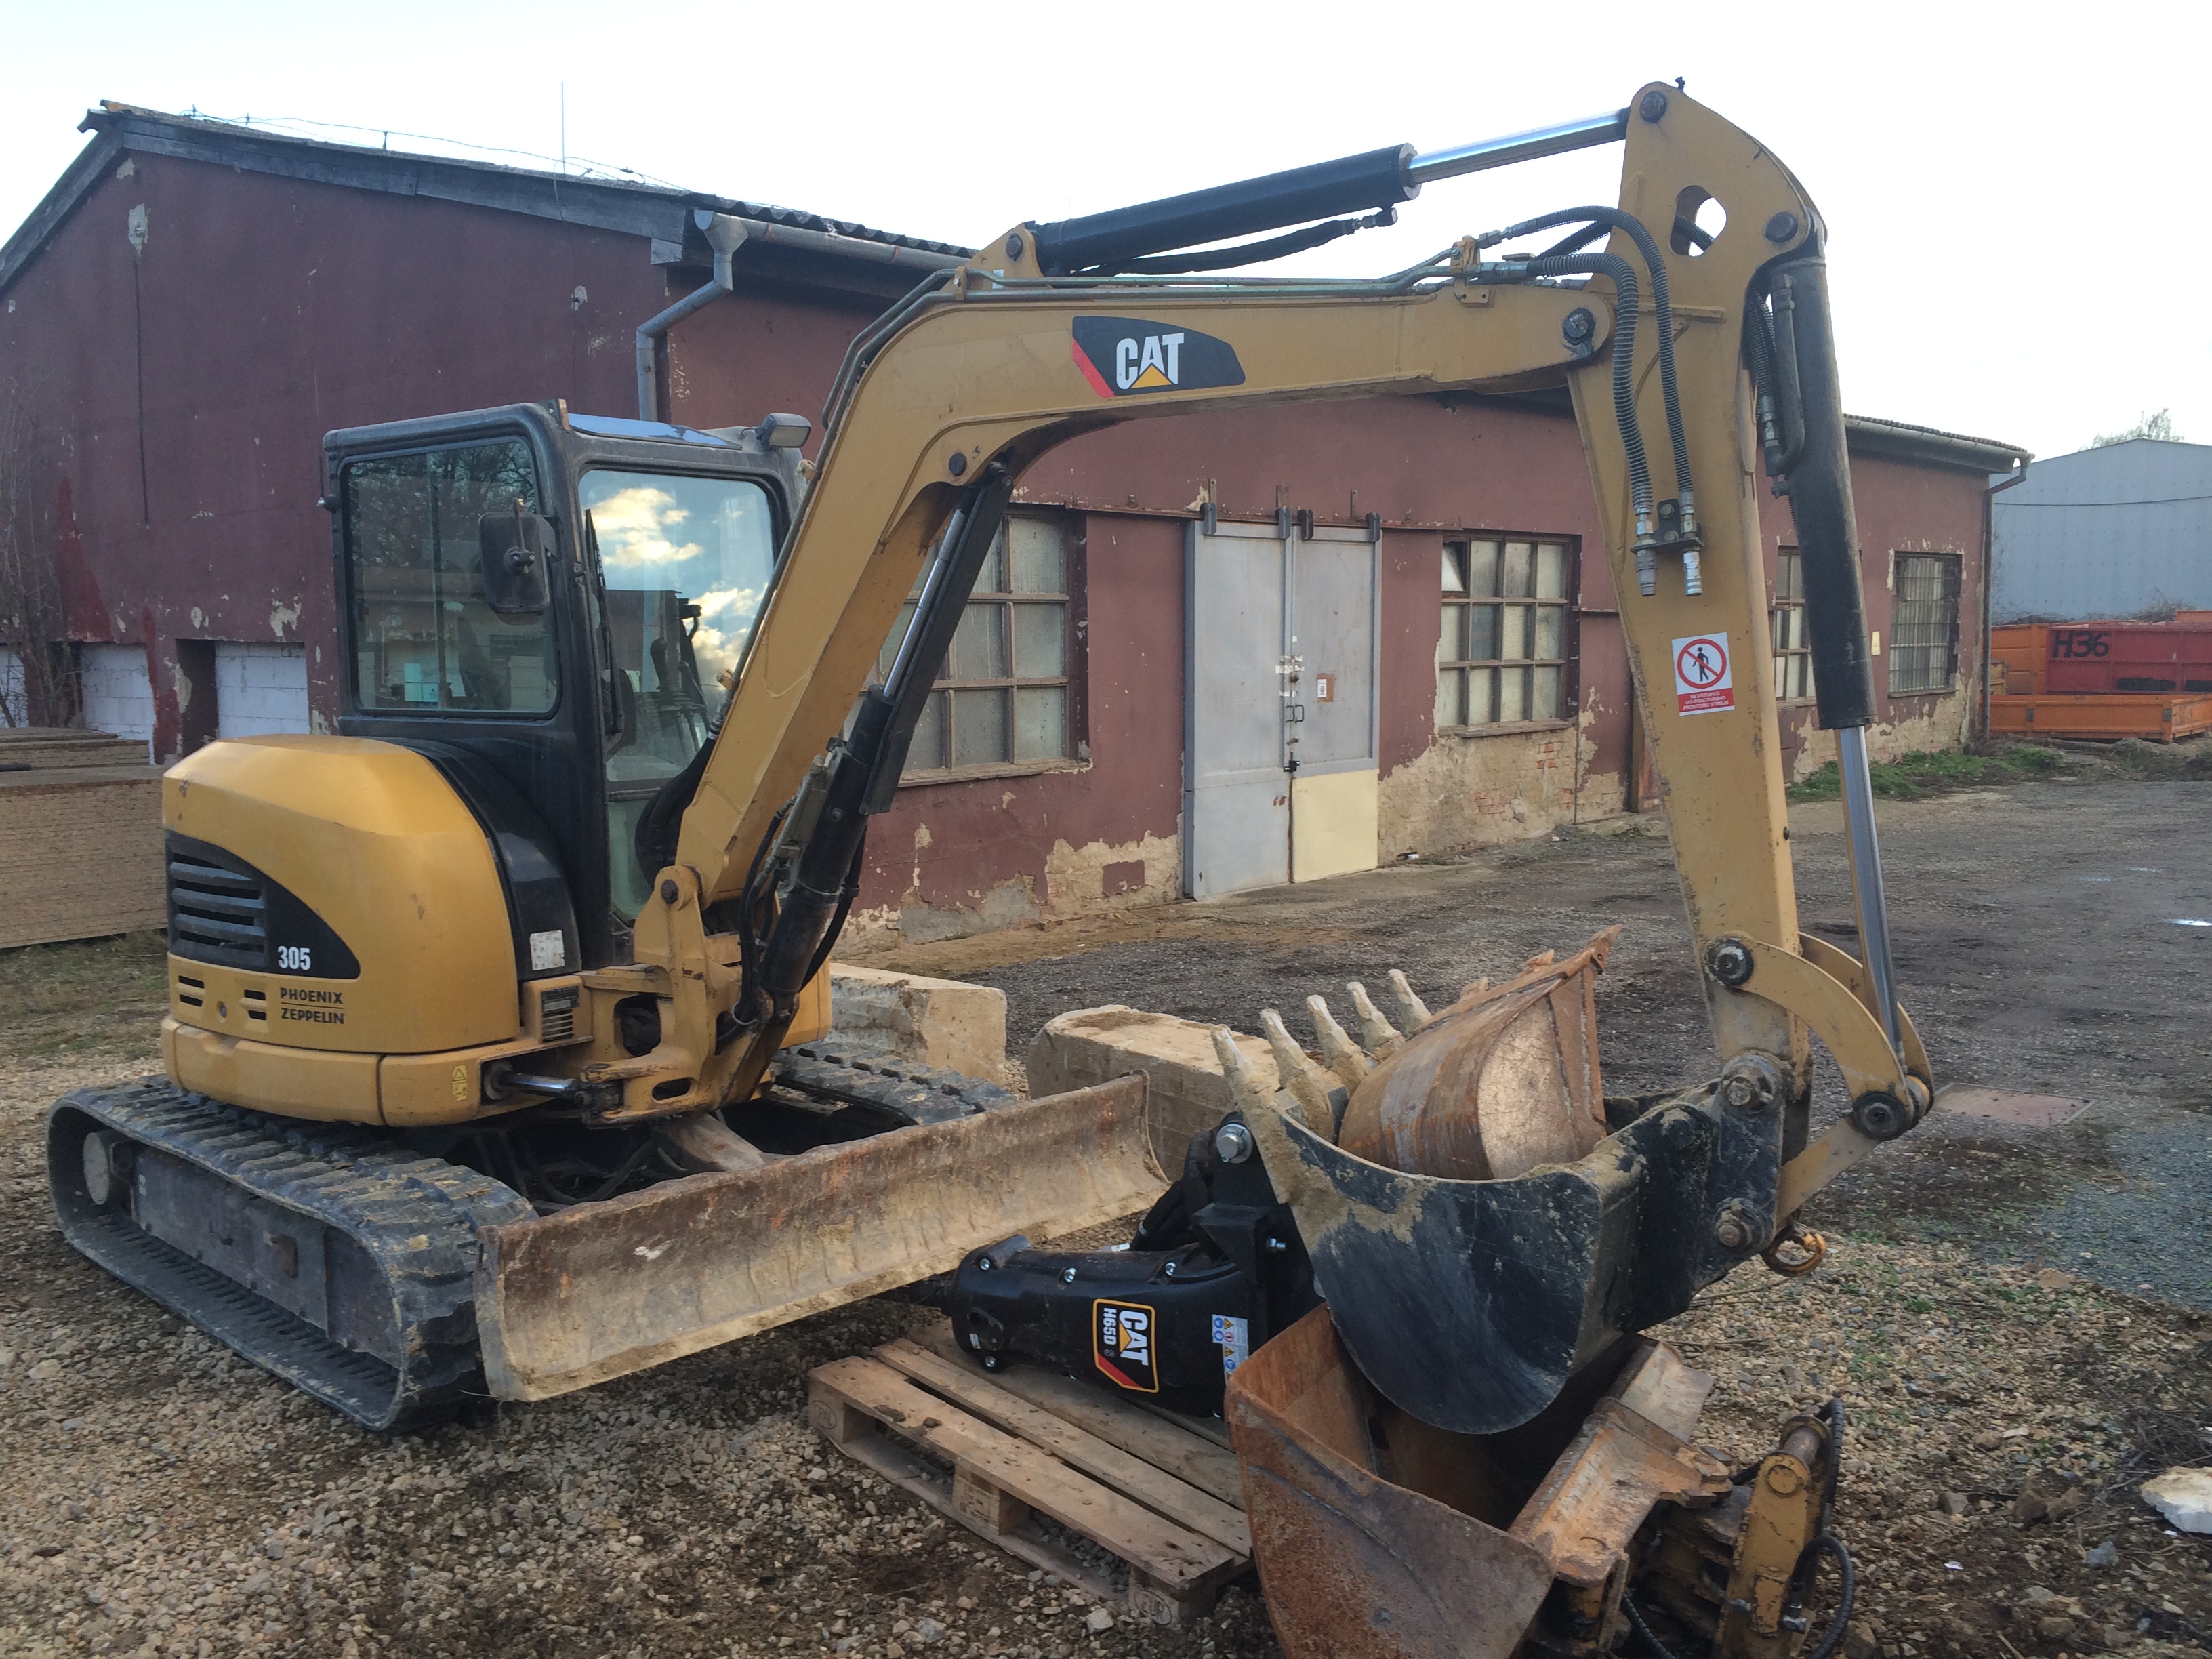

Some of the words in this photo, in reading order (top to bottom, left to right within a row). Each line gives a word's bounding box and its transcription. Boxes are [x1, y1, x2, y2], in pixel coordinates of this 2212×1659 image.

[1116, 332, 1185, 390] CAT
[2053, 630, 2111, 658] H36
[277, 945, 311, 970] 305
[280, 987, 344, 1004] PHOENIX
[281, 1008, 344, 1024] ZEPPELIN
[1103, 1307, 1117, 1345] H65D
[1119, 1310, 1149, 1366] CAT
